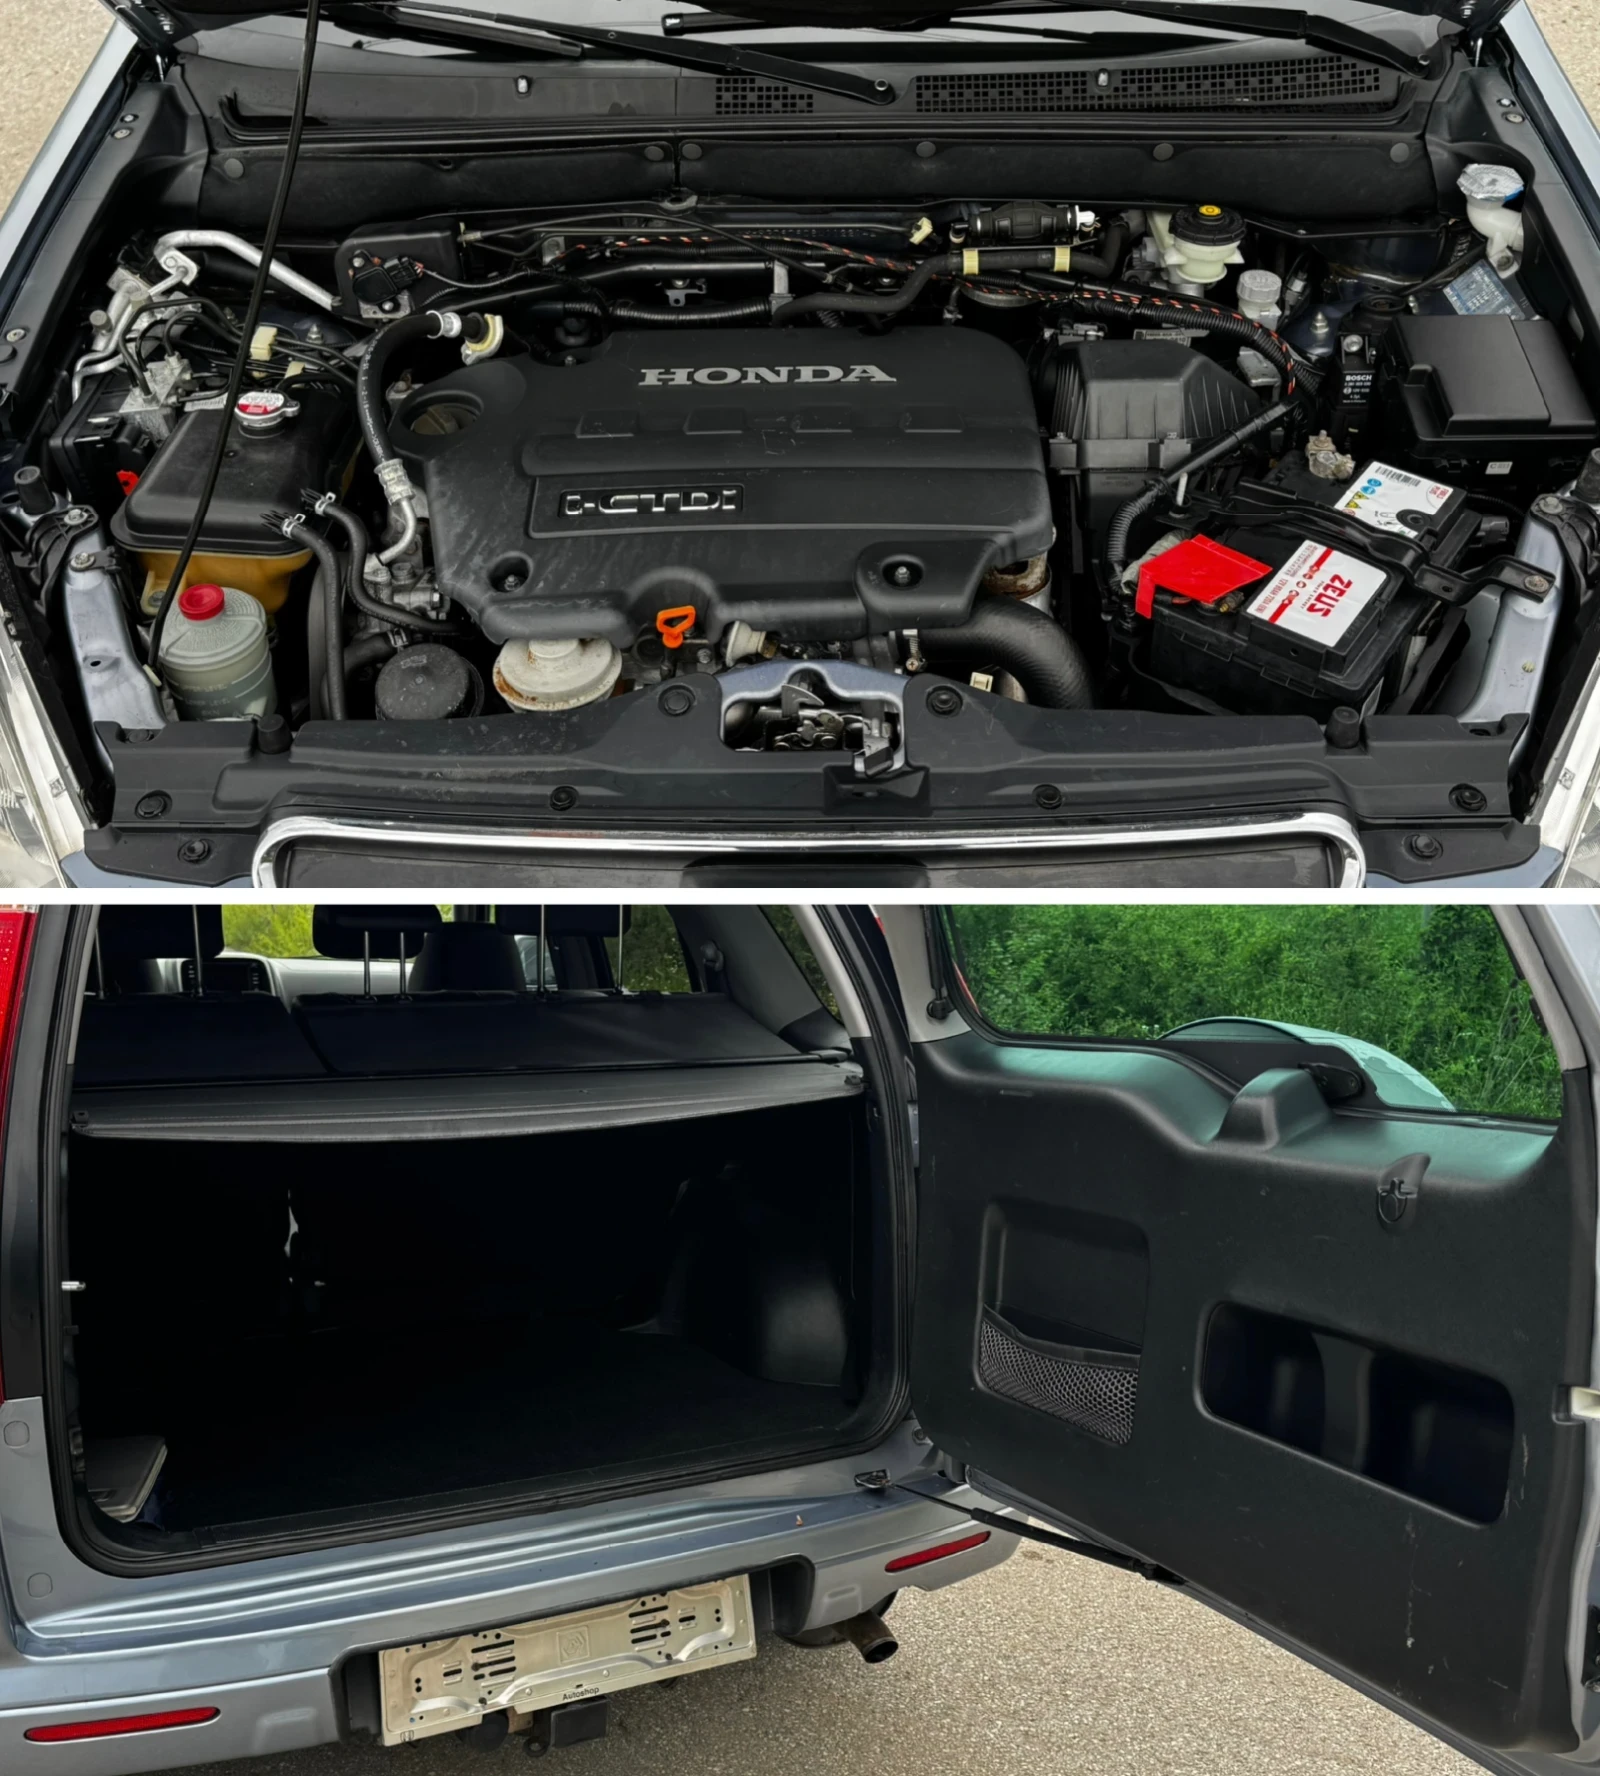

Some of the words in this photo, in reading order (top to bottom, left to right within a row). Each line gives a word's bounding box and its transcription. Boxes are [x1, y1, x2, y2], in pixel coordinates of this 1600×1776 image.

[638, 365, 897, 386] HONDA
[1306, 574, 1353, 617] ZEUS
[562, 1687, 599, 1701] Autoshop
